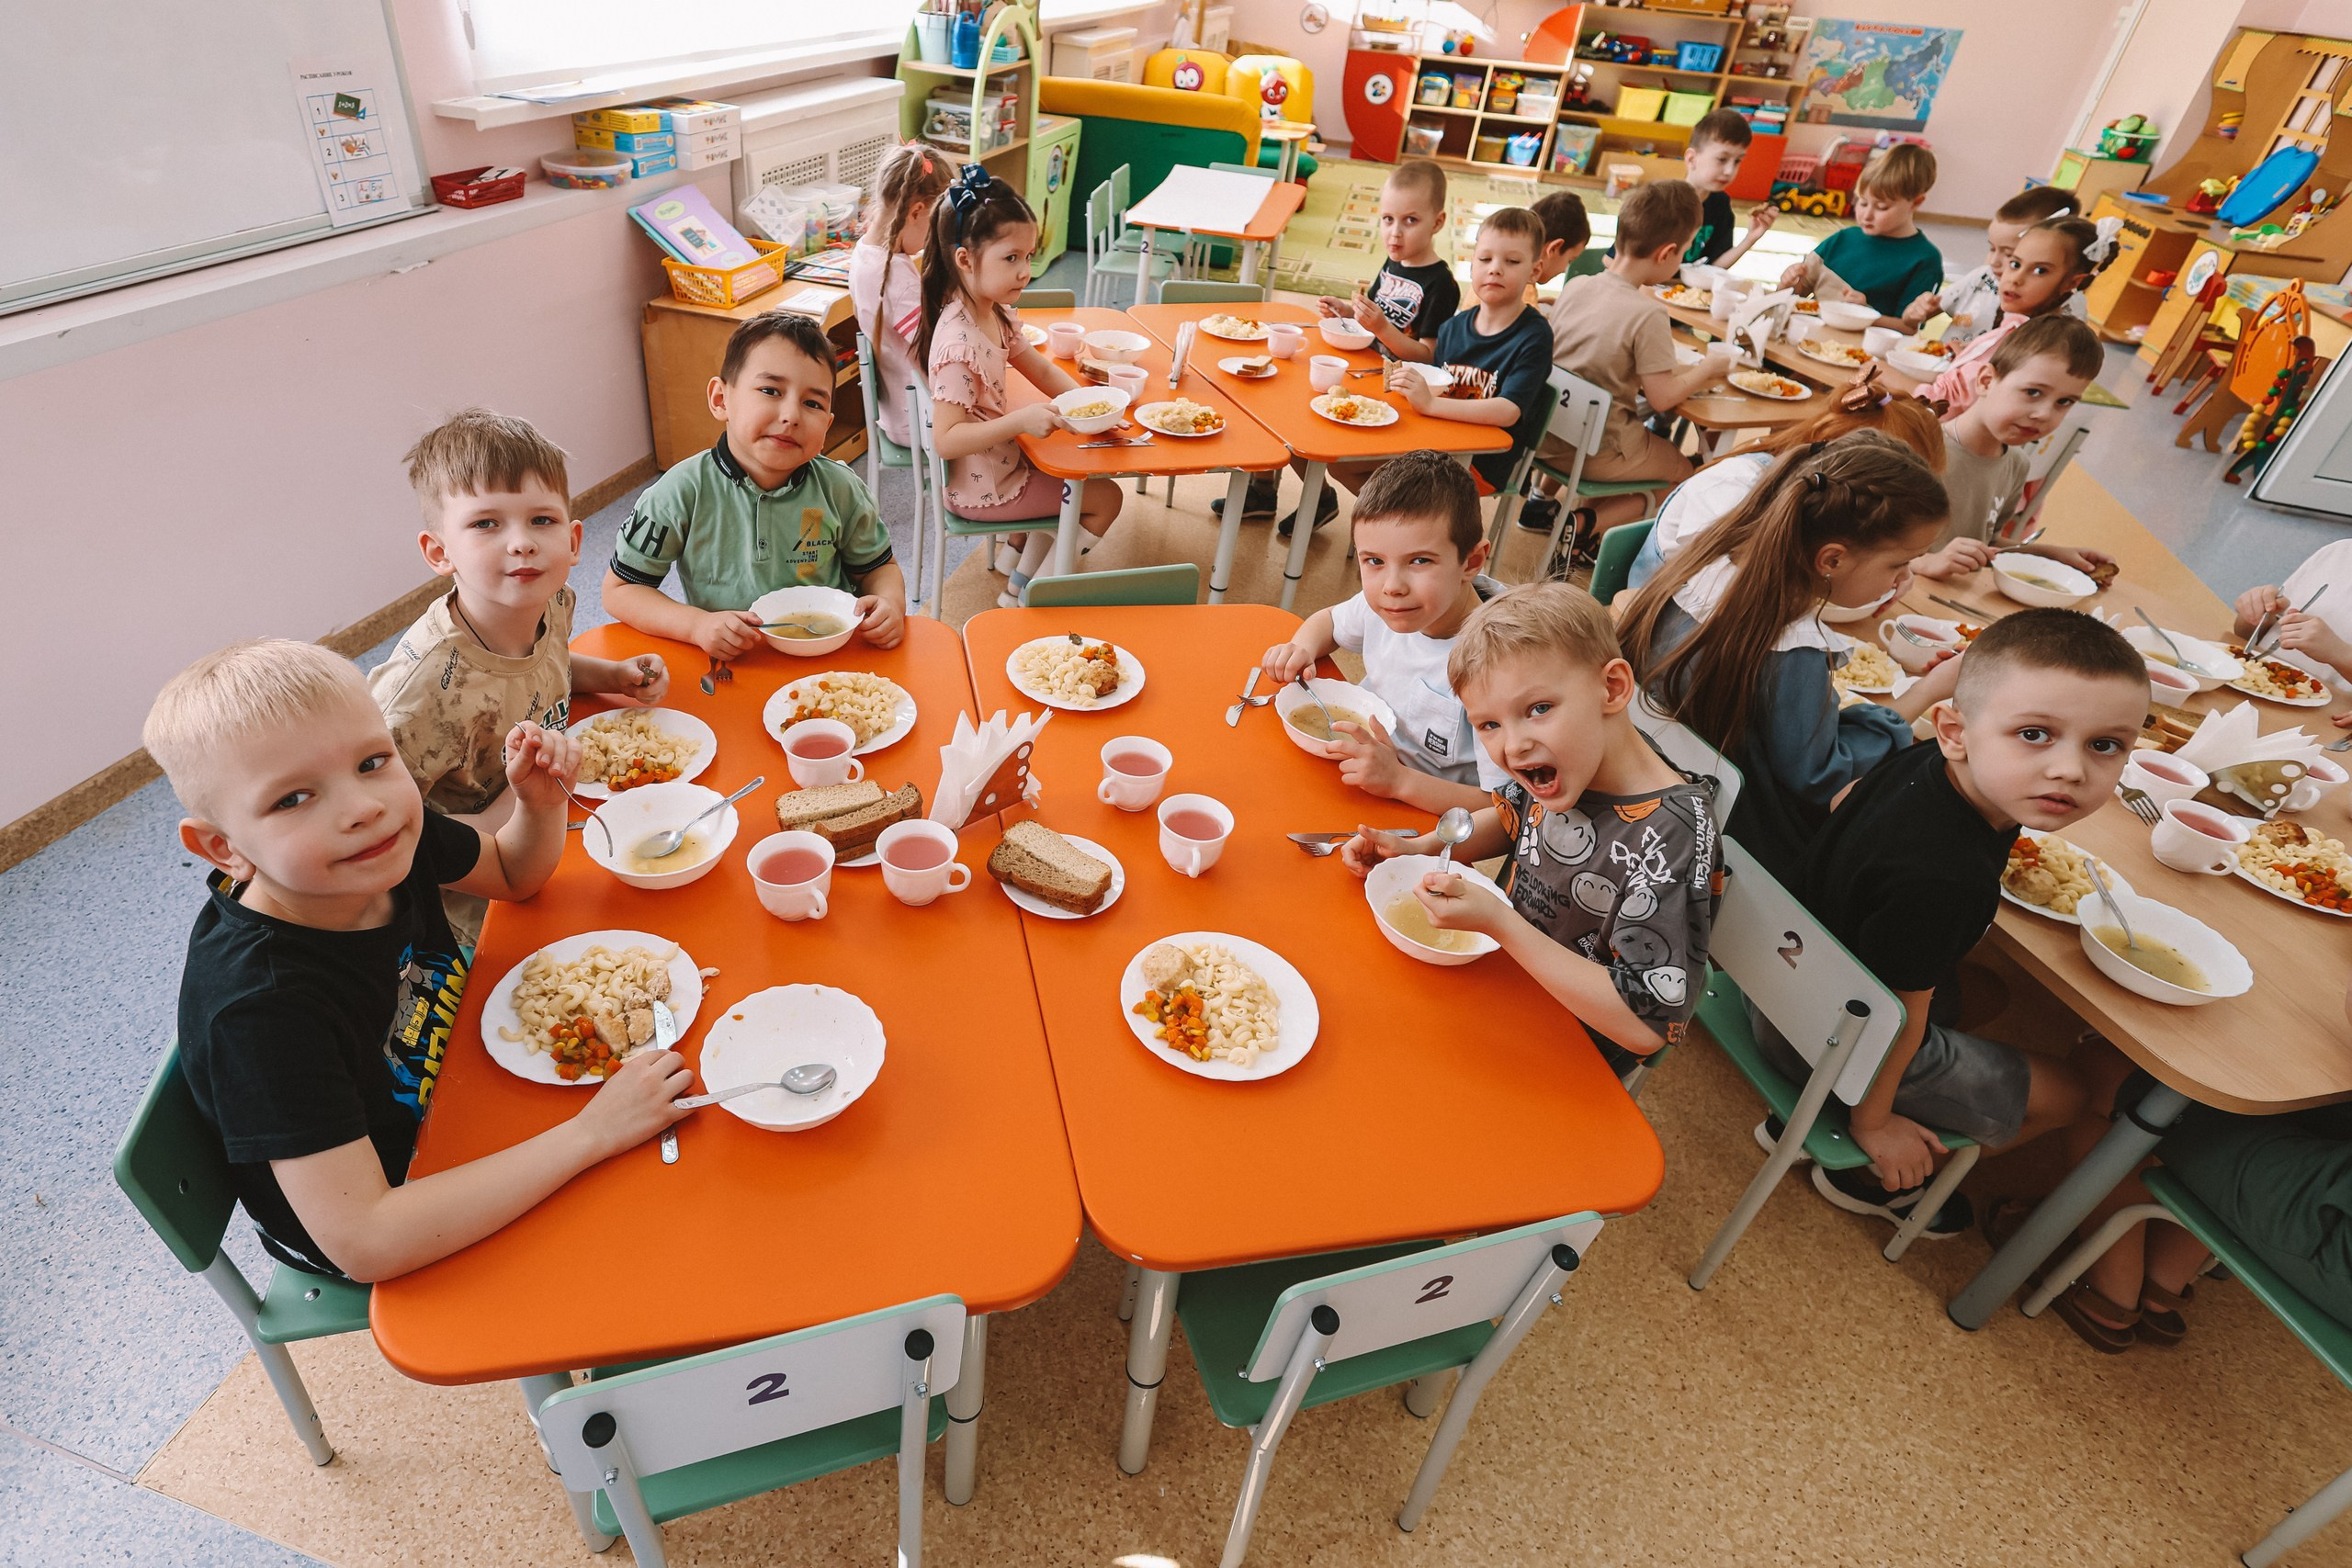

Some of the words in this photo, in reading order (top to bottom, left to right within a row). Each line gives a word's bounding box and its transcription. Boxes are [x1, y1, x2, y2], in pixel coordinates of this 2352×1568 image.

[316, 107, 322, 116] 1
[325, 148, 332, 156] 2
[339, 194, 345, 202] 3
[1140, 241, 1148, 254] 2
[1559, 389, 1571, 408] 2
[1061, 482, 1071, 504] 2
[1515, 883, 1557, 919] FORWARD
[1529, 874, 1571, 909] LOOKING
[1777, 931, 1804, 970] 2
[1415, 1275, 1453, 1304] 2
[746, 1372, 790, 1406] 2
